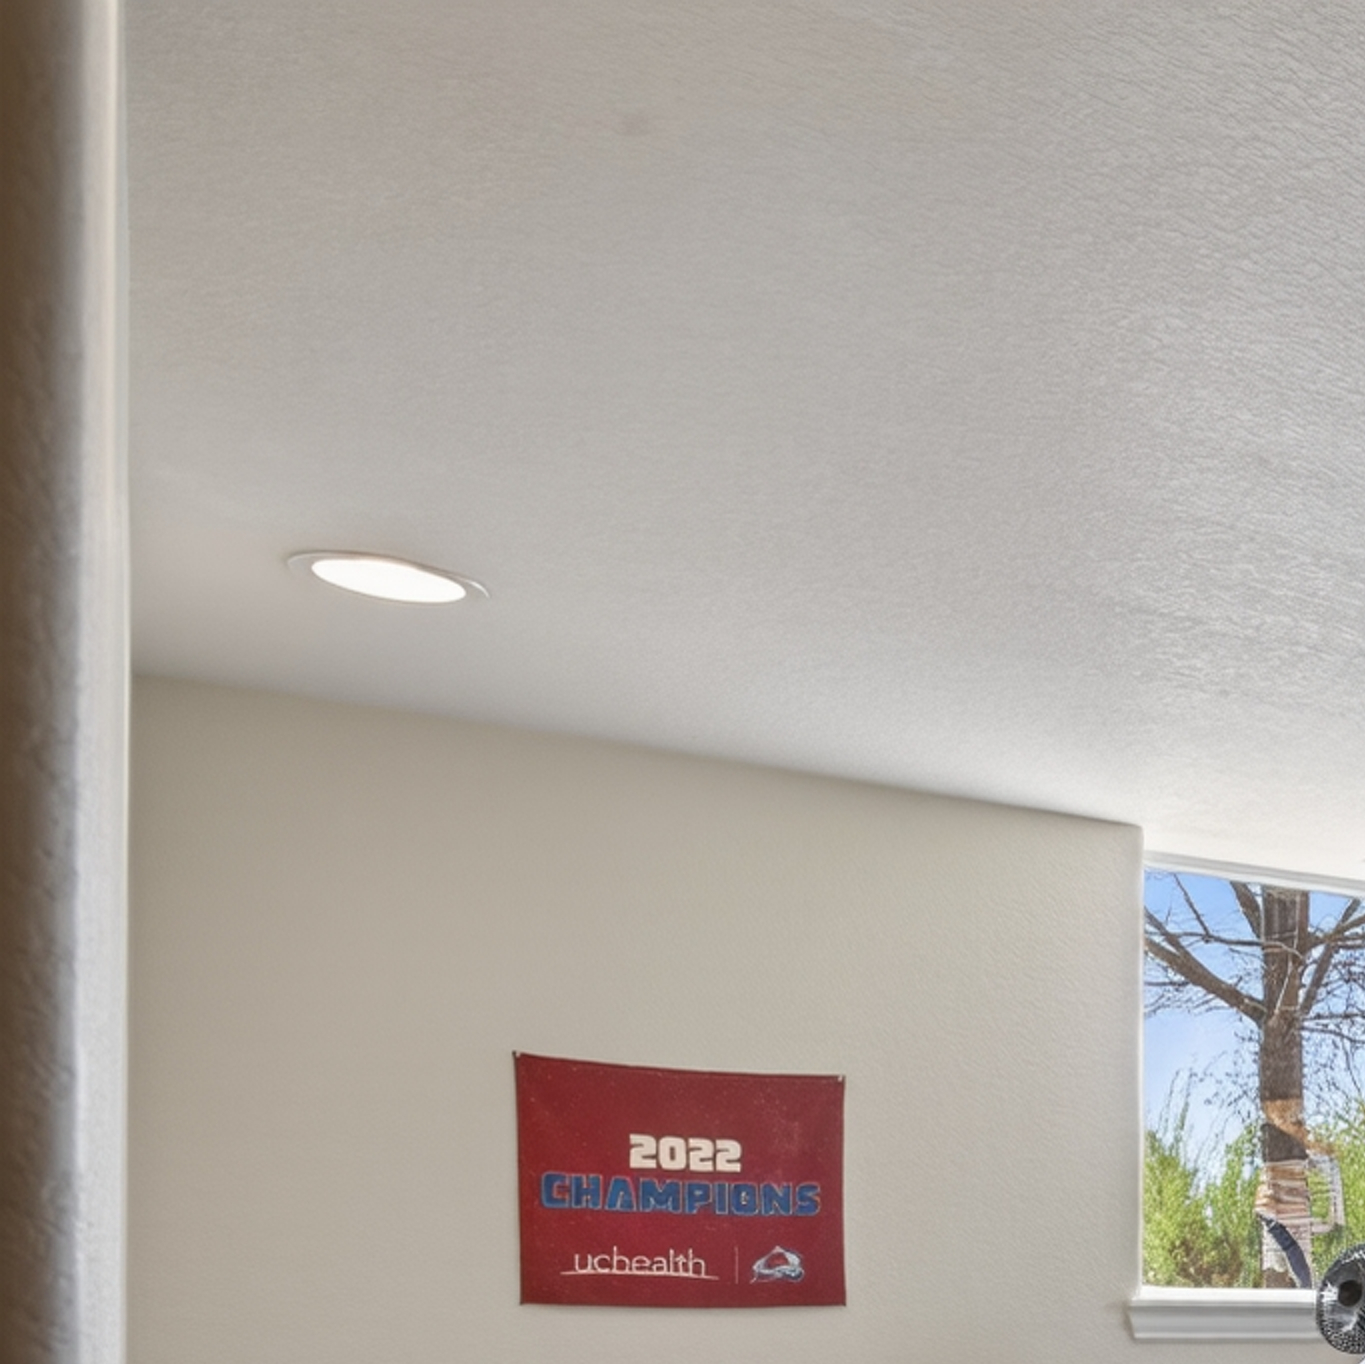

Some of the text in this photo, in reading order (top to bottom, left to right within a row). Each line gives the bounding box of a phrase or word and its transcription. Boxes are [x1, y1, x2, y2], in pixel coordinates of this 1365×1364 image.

[629, 1133, 742, 1173] 2022
[540, 1170, 821, 1216] CHAMPIONS
[573, 1246, 707, 1278] uchealth
